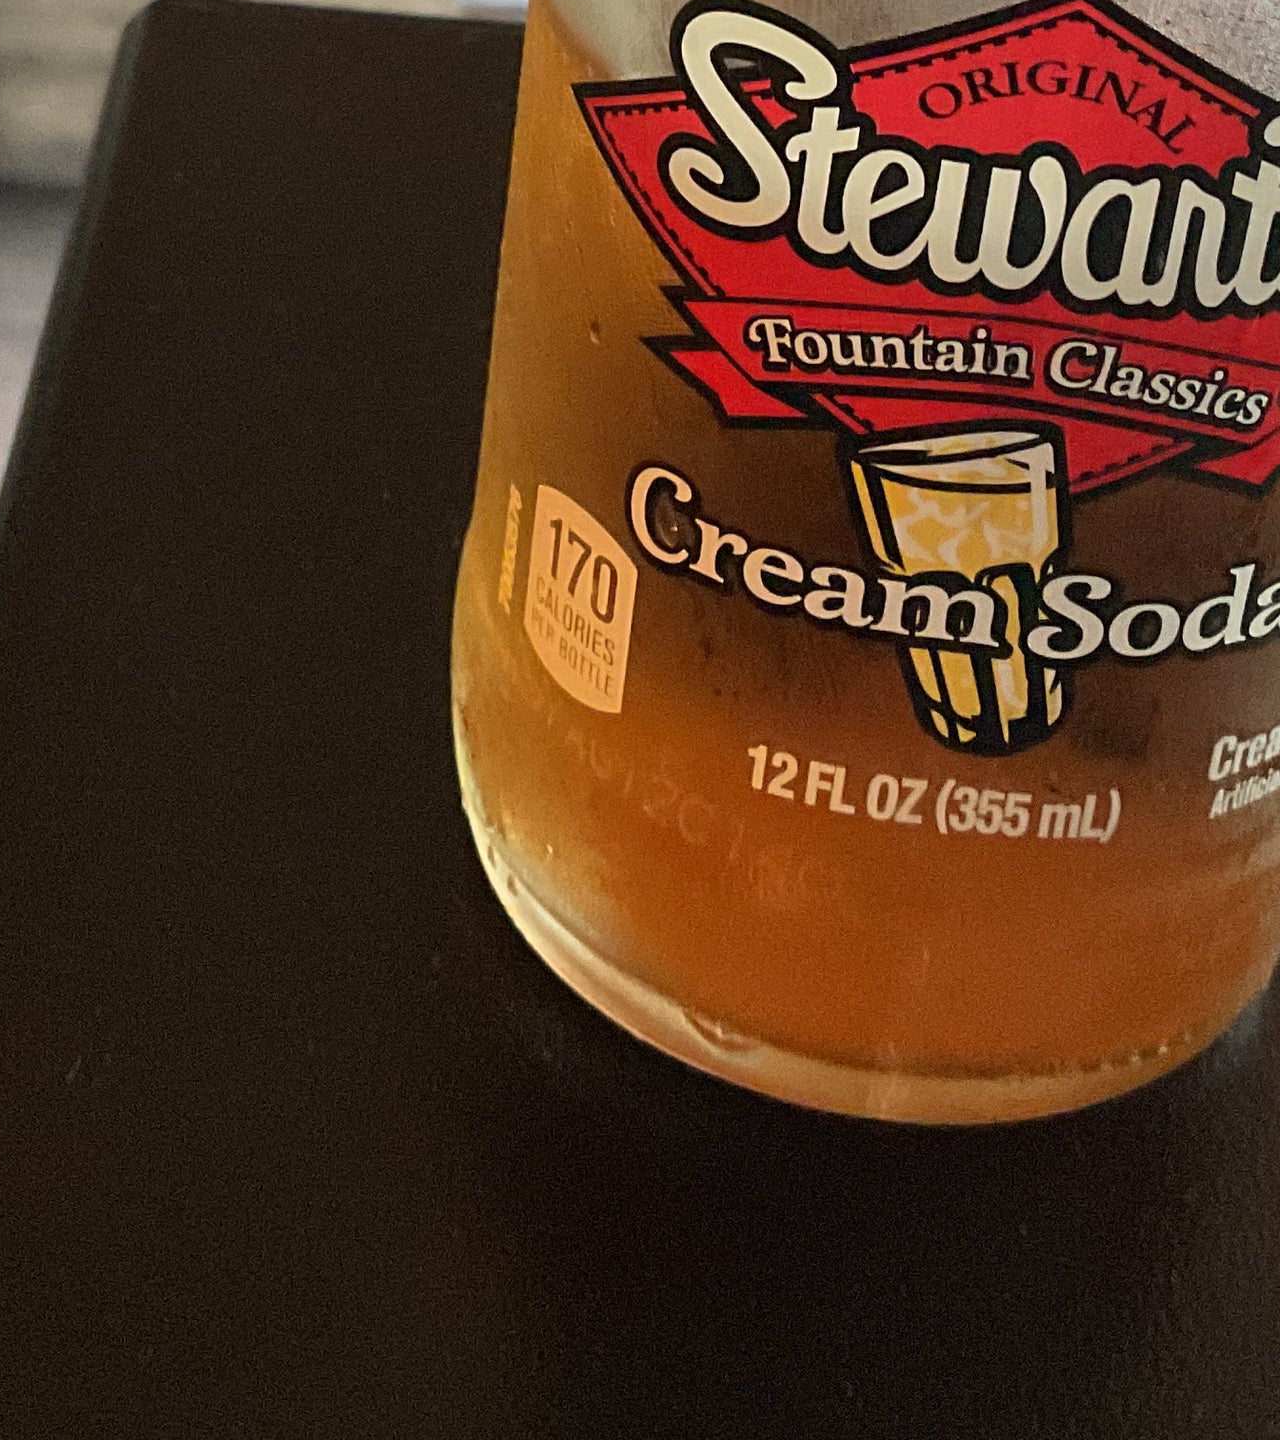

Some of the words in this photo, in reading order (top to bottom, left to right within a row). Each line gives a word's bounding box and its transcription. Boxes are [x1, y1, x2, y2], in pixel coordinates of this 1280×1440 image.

[917, 59, 1197, 155] ORIGINAL
[748, 316, 1032, 382] Fountain
[1048, 339, 1271, 426] Classics
[549, 517, 619, 625] 170
[629, 465, 1000, 649] Cream
[535, 576, 616, 667] CALORIES
[558, 637, 615, 697] BOTTLE
[747, 743, 799, 801] 12
[803, 759, 856, 816] FL
[865, 772, 930, 825] OZ
[934, 777, 1033, 839] (355
[1036, 786, 1122, 845] mL)
